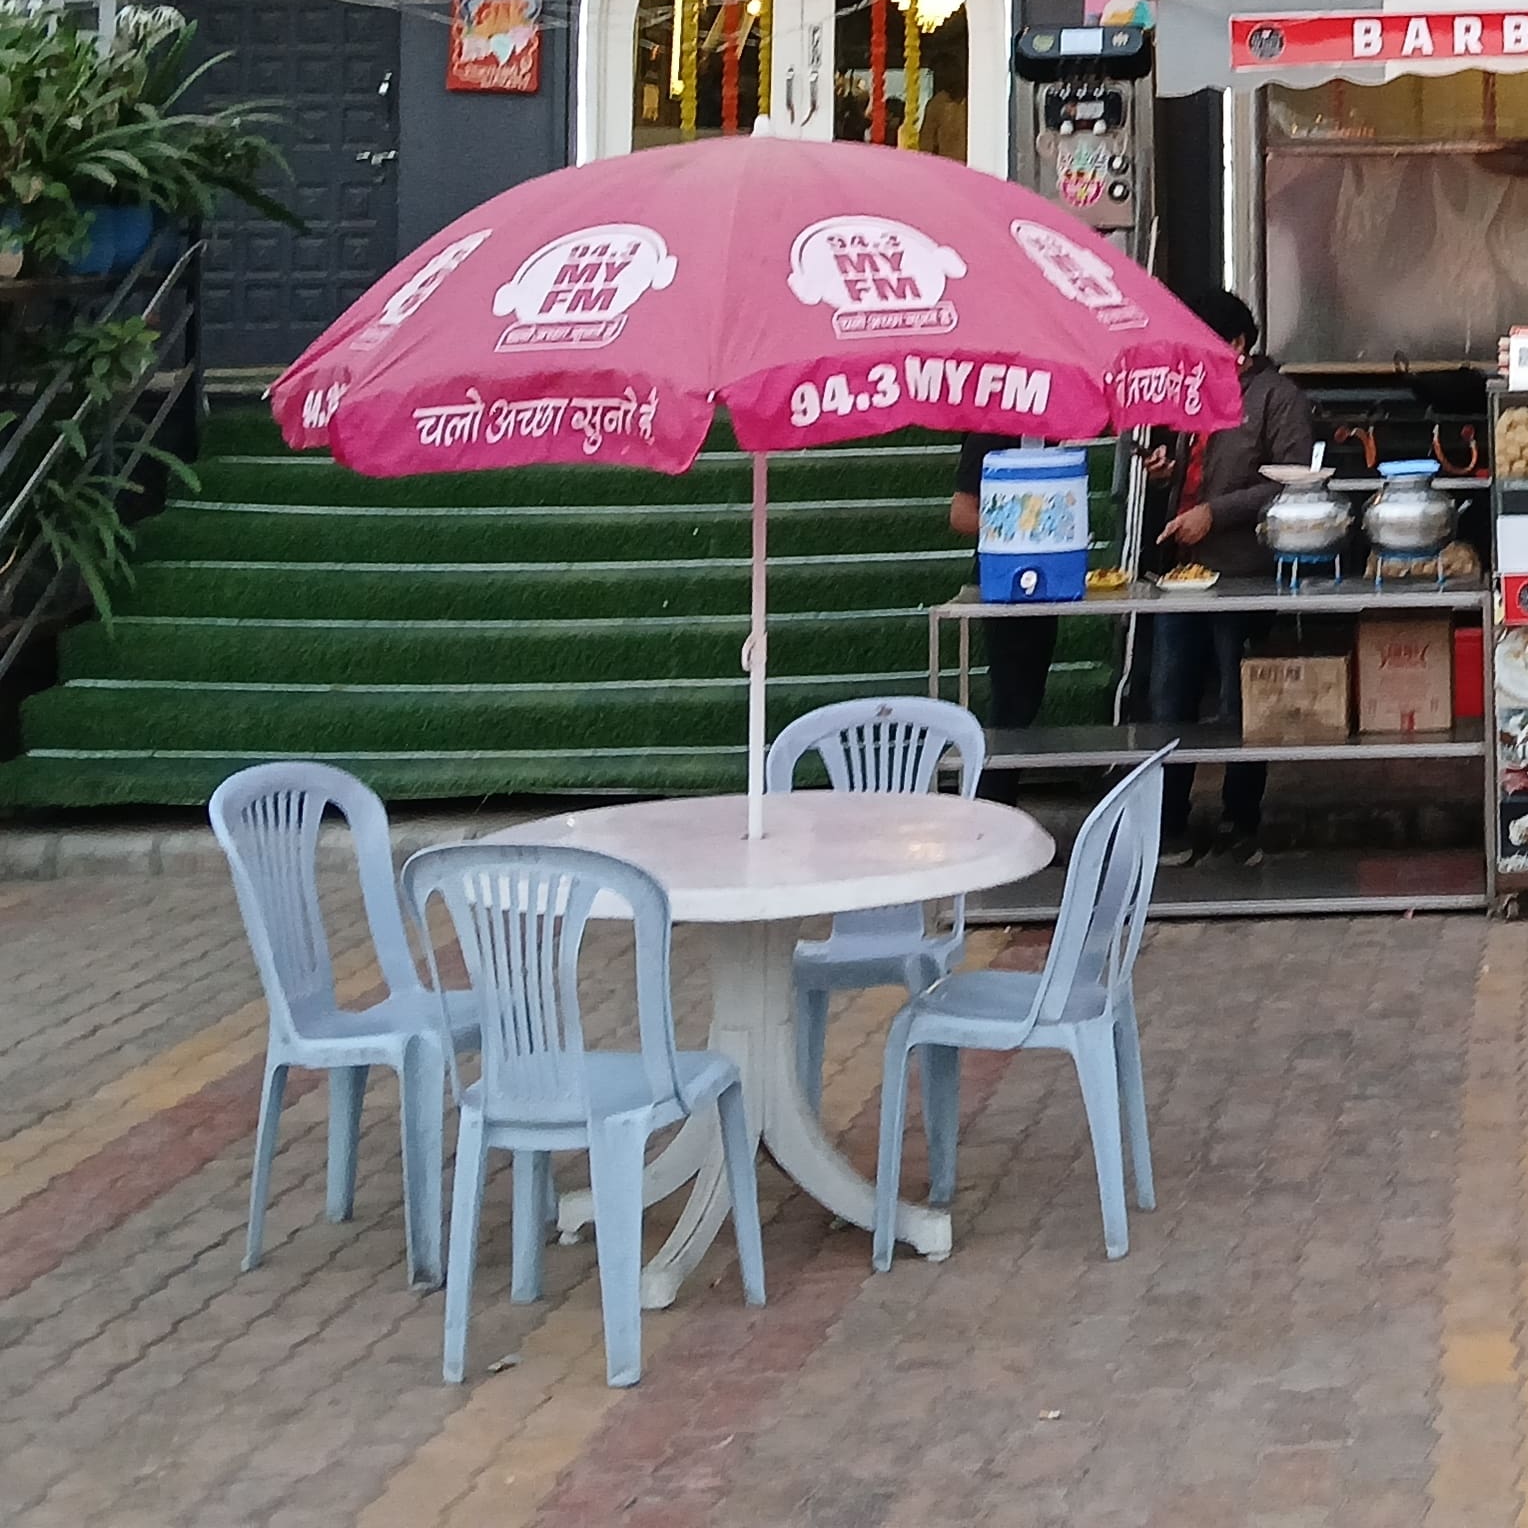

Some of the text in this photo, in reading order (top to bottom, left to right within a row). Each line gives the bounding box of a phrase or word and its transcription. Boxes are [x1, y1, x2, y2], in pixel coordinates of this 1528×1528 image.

[553, 261, 632, 286] MY
[833, 251, 905, 274] MY
[537, 287, 619, 315] FM
[844, 277, 922, 303] FM
[789, 362, 903, 427] 94.3
[905, 355, 975, 407] MY
[975, 361, 1053, 416] FM
[412, 386, 485, 448] चलो
